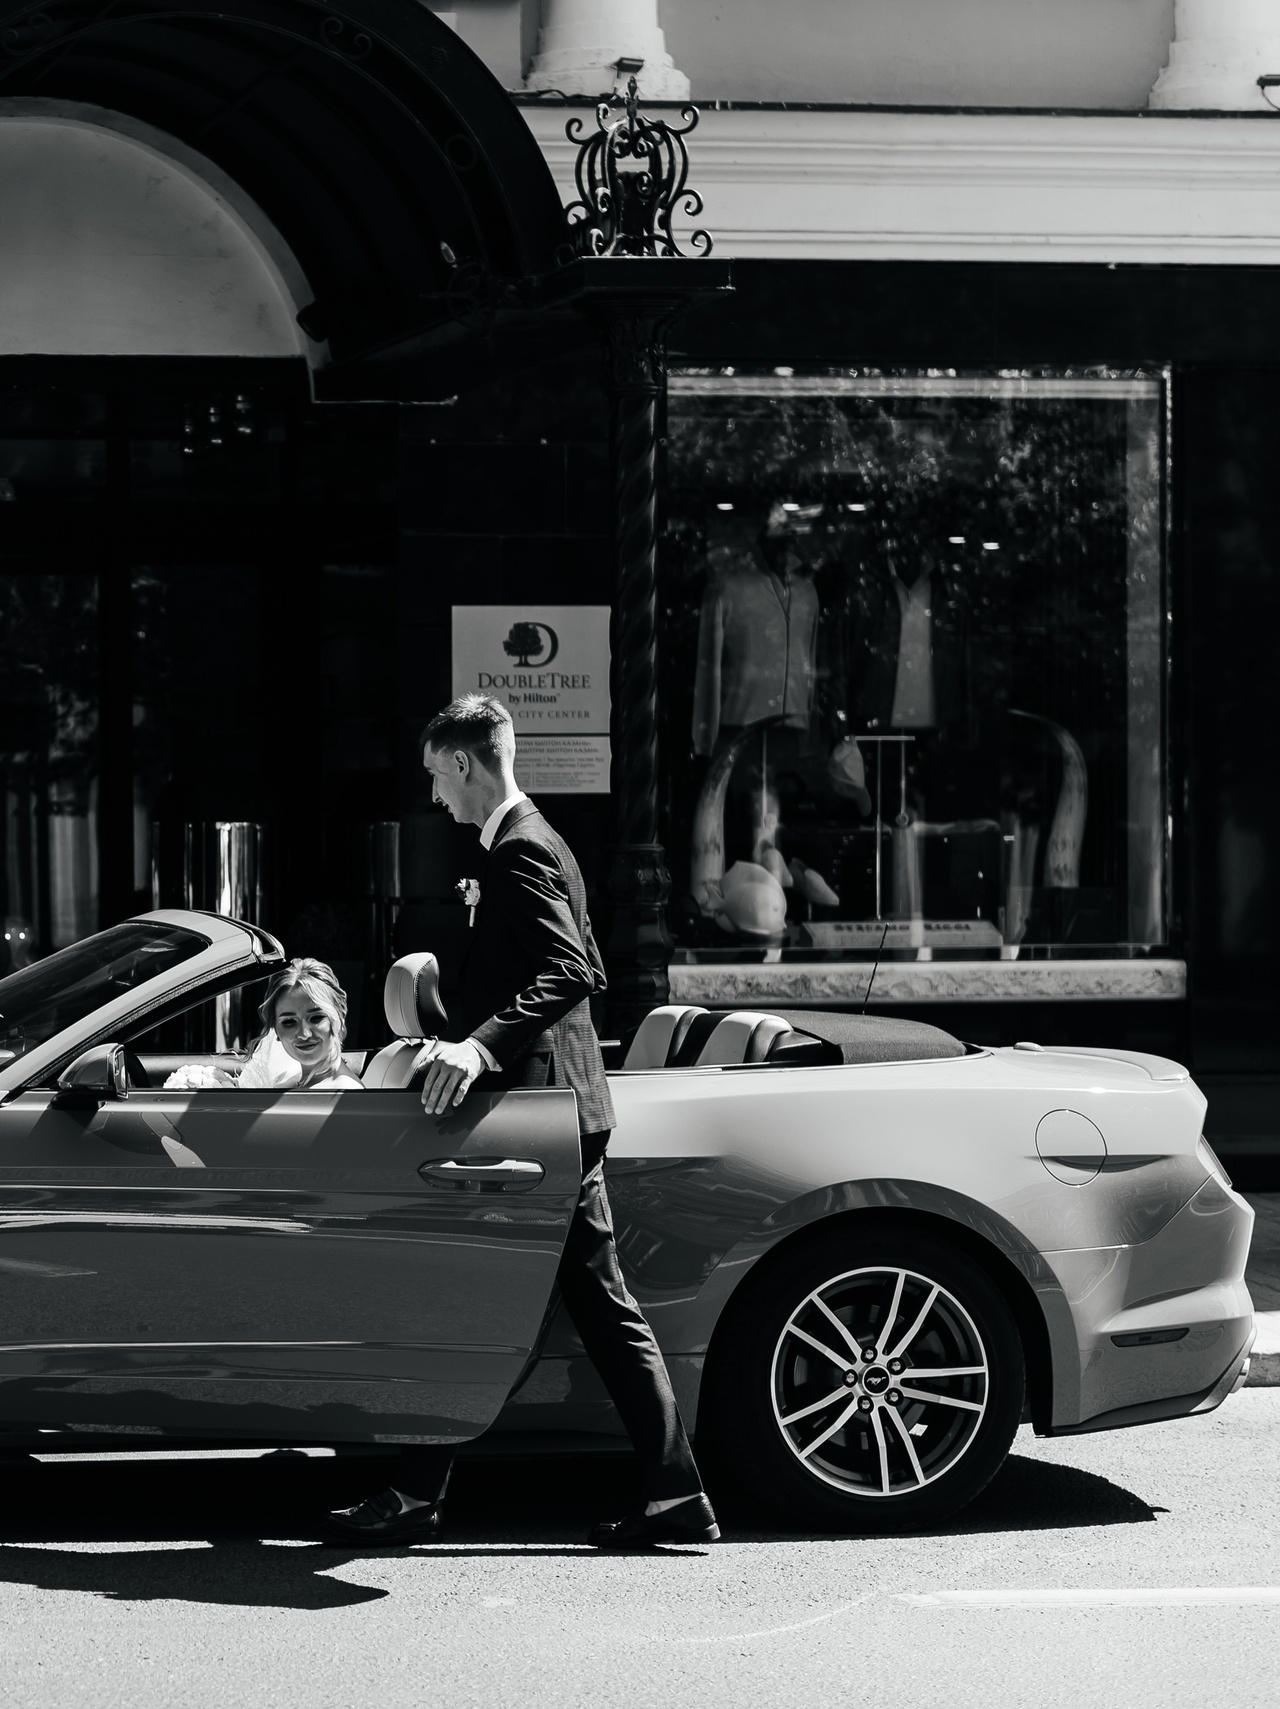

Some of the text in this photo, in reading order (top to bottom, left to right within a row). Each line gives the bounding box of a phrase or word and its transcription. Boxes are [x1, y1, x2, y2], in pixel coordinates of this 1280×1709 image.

[508, 693, 521, 706] by
[517, 710, 543, 719] CITY
[548, 710, 590, 719] CENTER
